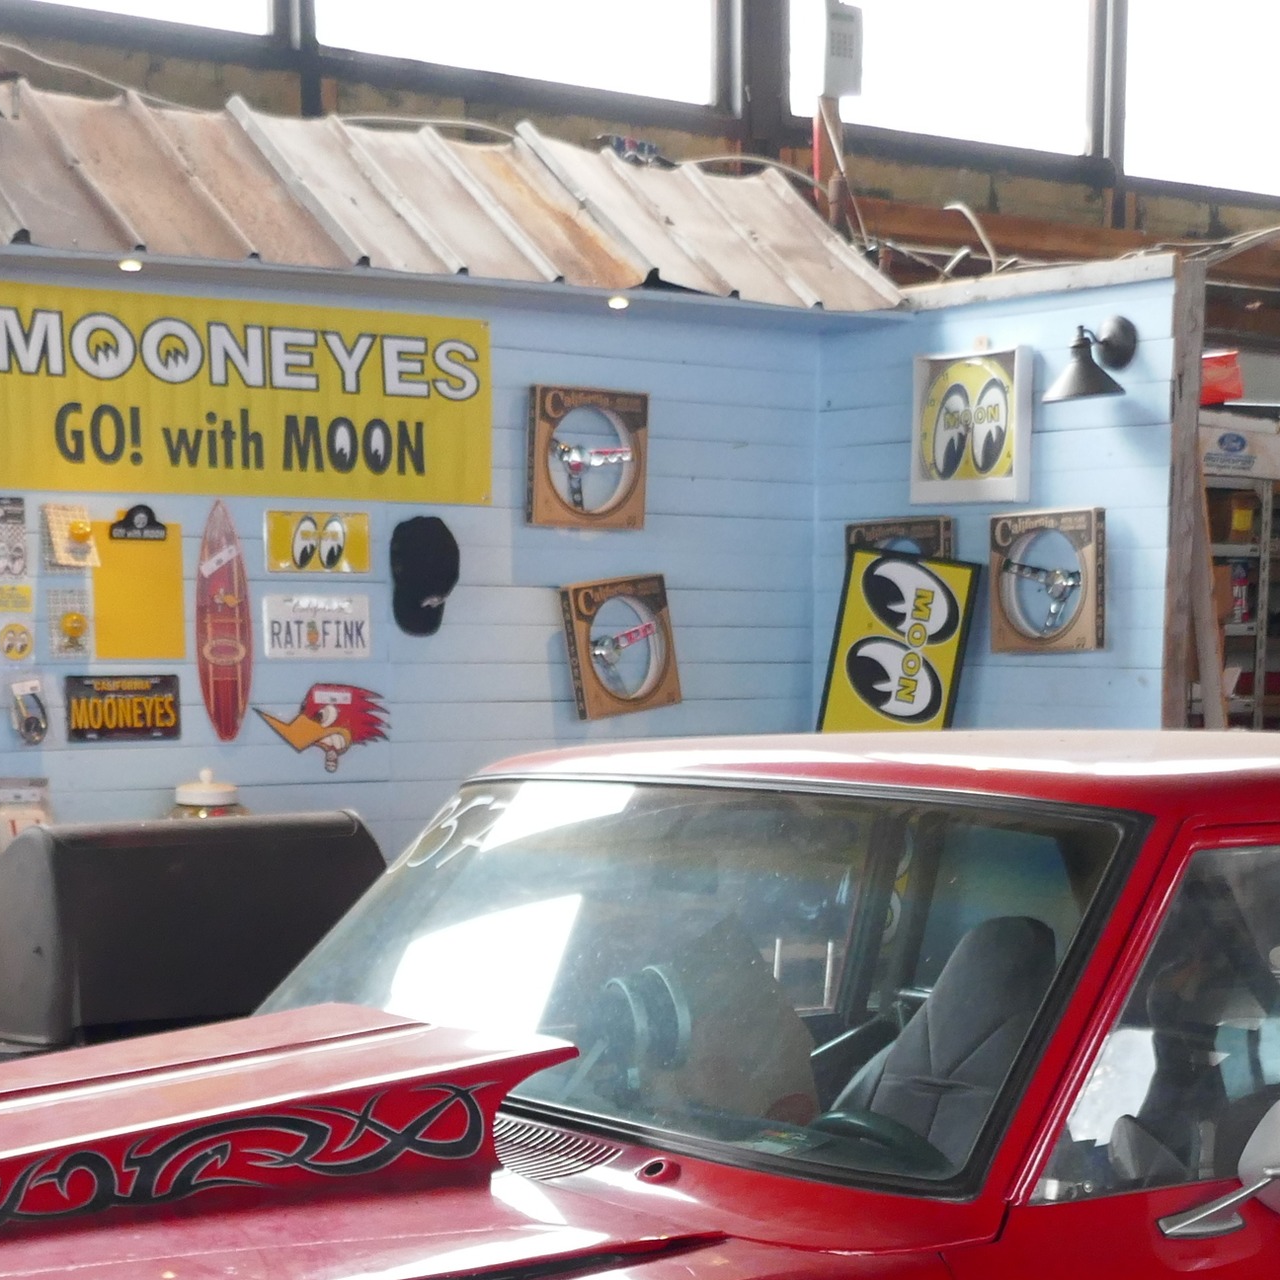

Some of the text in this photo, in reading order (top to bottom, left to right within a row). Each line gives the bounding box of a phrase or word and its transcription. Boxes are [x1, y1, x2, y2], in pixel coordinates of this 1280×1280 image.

[943, 404, 1000, 430] MOON
[55, 402, 426, 475] GO! with MOON
[996, 518, 1055, 547] California
[271, 621, 366, 649] RAT FINK
[894, 588, 935, 706] MOON
[70, 696, 178, 730] MOONEYES
